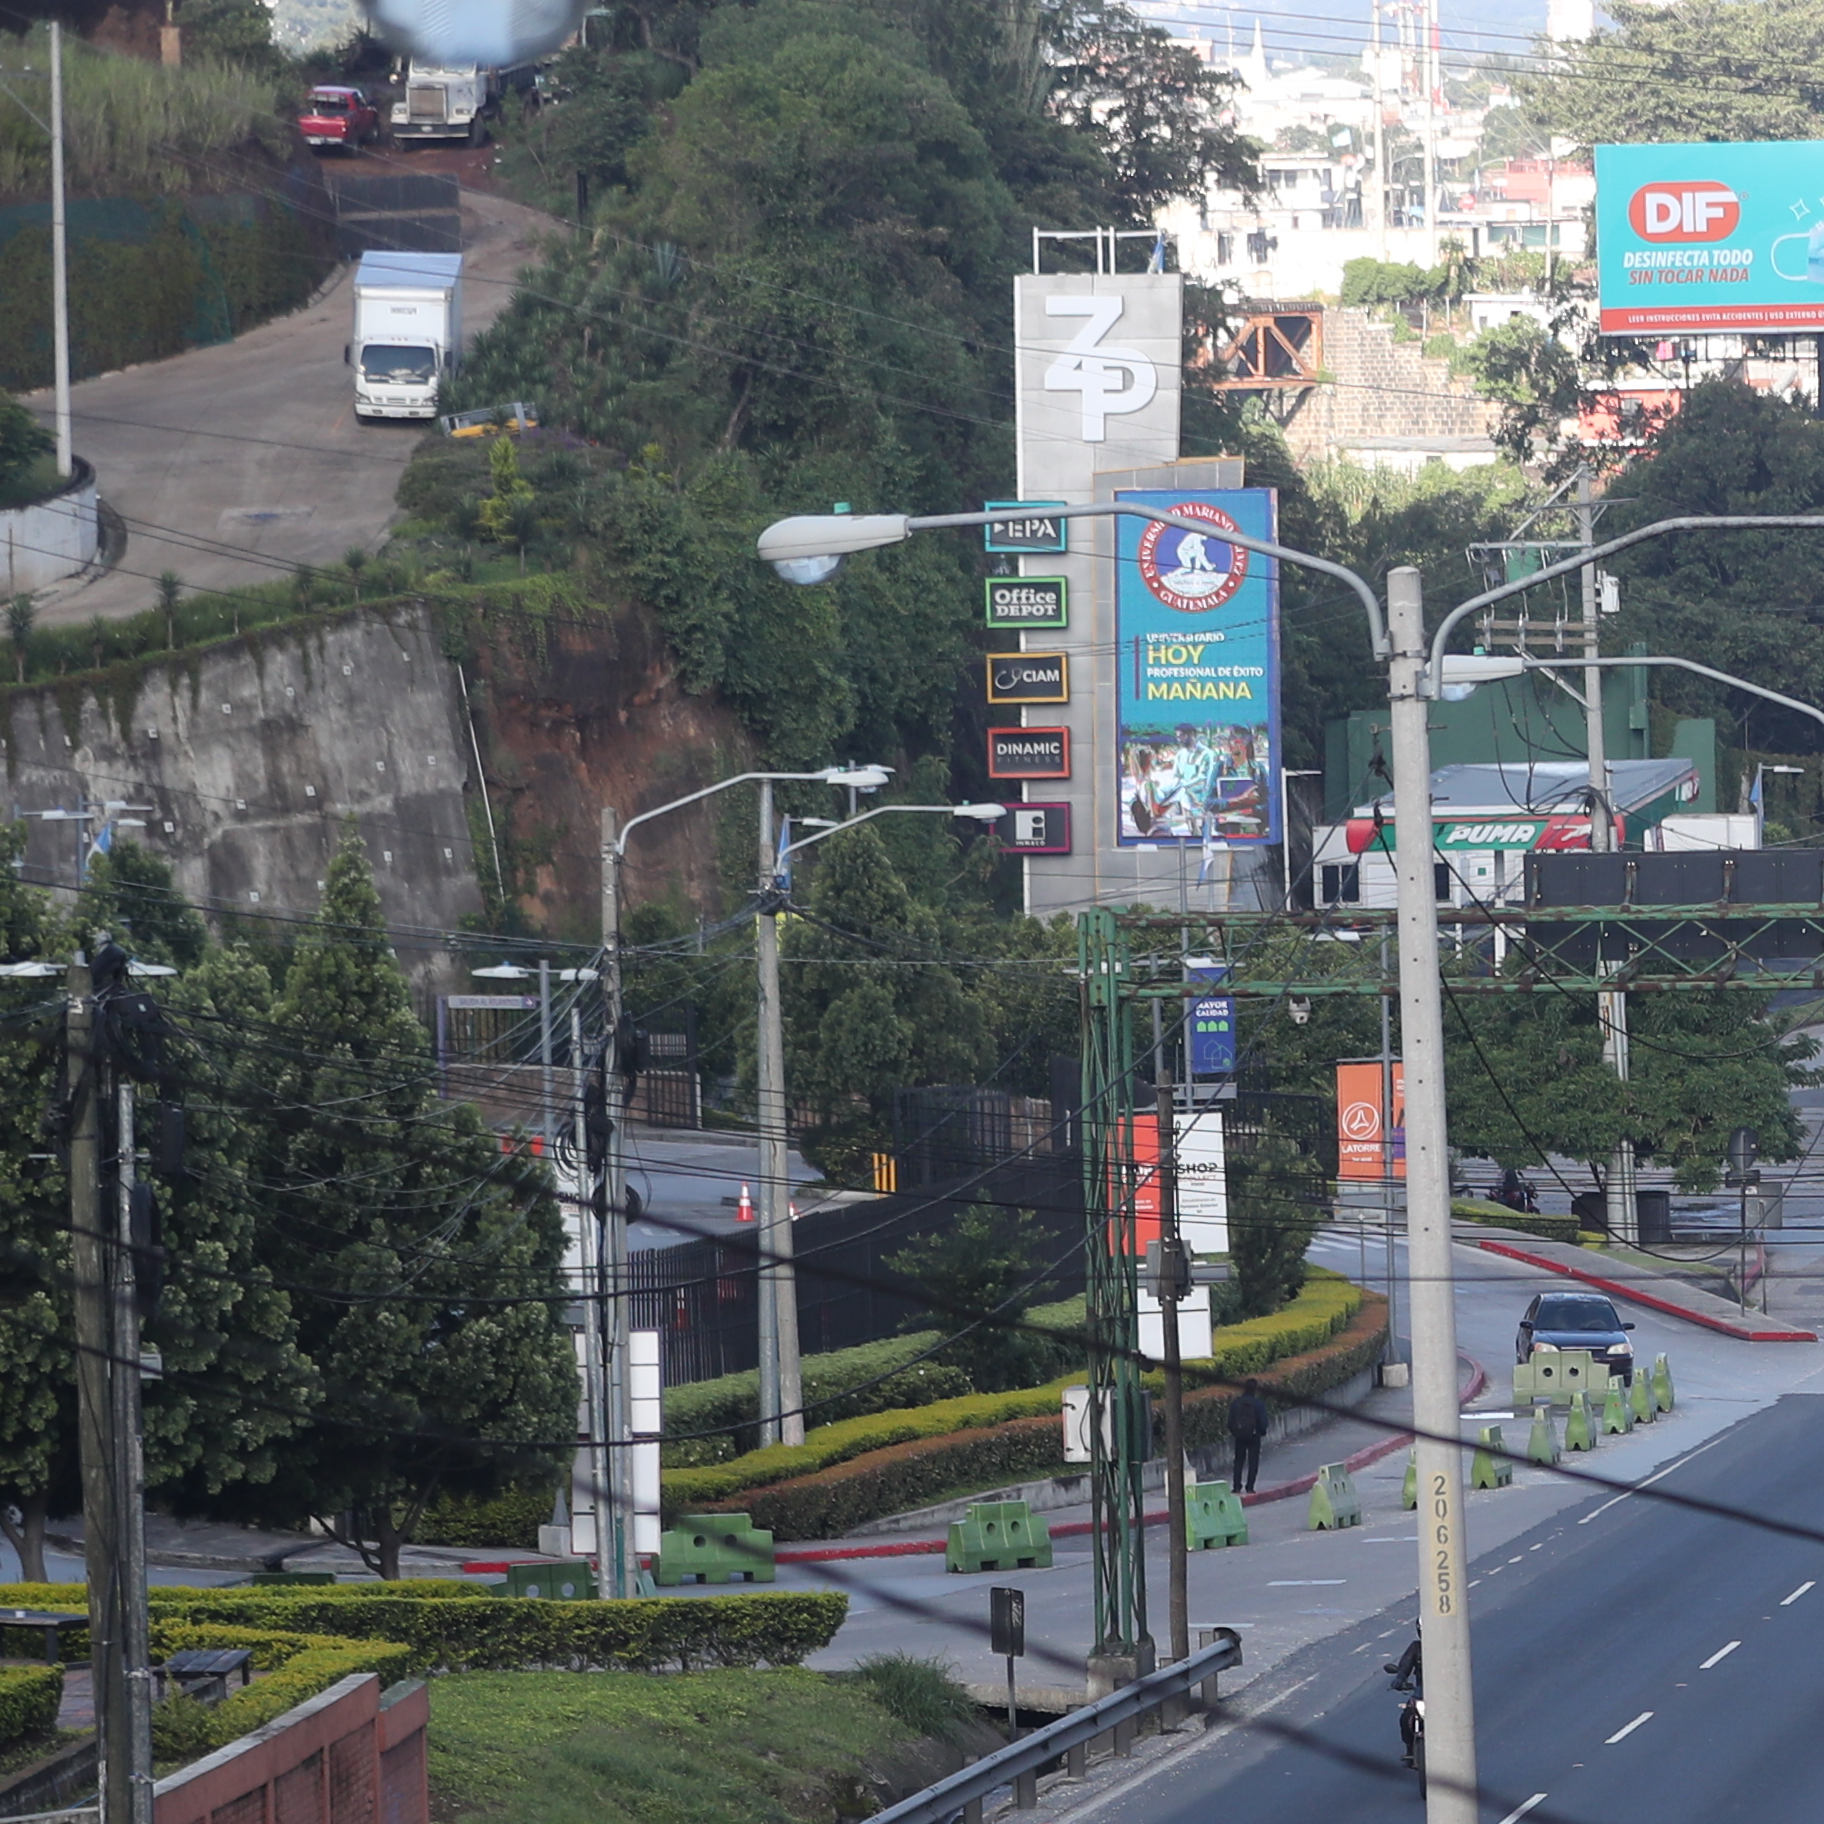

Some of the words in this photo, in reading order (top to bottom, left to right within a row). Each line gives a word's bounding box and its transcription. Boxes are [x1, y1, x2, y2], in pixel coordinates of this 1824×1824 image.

[1645, 191, 1739, 234] DIF
[1623, 250, 1710, 269] DESINFECTA
[1713, 248, 1753, 267] TODO
[1629, 270, 1653, 285] SIN
[1656, 268, 1704, 284] TOCAR
[1709, 267, 1749, 283] NADA
[1008, 519, 1057, 538] EPA
[994, 588, 1057, 605] Office
[1158, 588, 1228, 612] GUATEMALA
[996, 605, 1057, 617] DEPOT
[1147, 645, 1205, 665] HOY
[1022, 668, 1060, 683] CIAM
[1147, 666, 1217, 677] PROFESIONAL
[1217, 667, 1232, 677] DE
[1233, 664, 1264, 677] ÉXITO
[1147, 678, 1252, 700] MAÑANA
[997, 742, 1061, 755] DINAMIC
[1446, 824, 1536, 844] PUMA
[1196, 1009, 1229, 1017] CALIDAD
[1342, 1144, 1381, 1153] LATORRE
[1433, 1474, 1453, 1615] 206258
